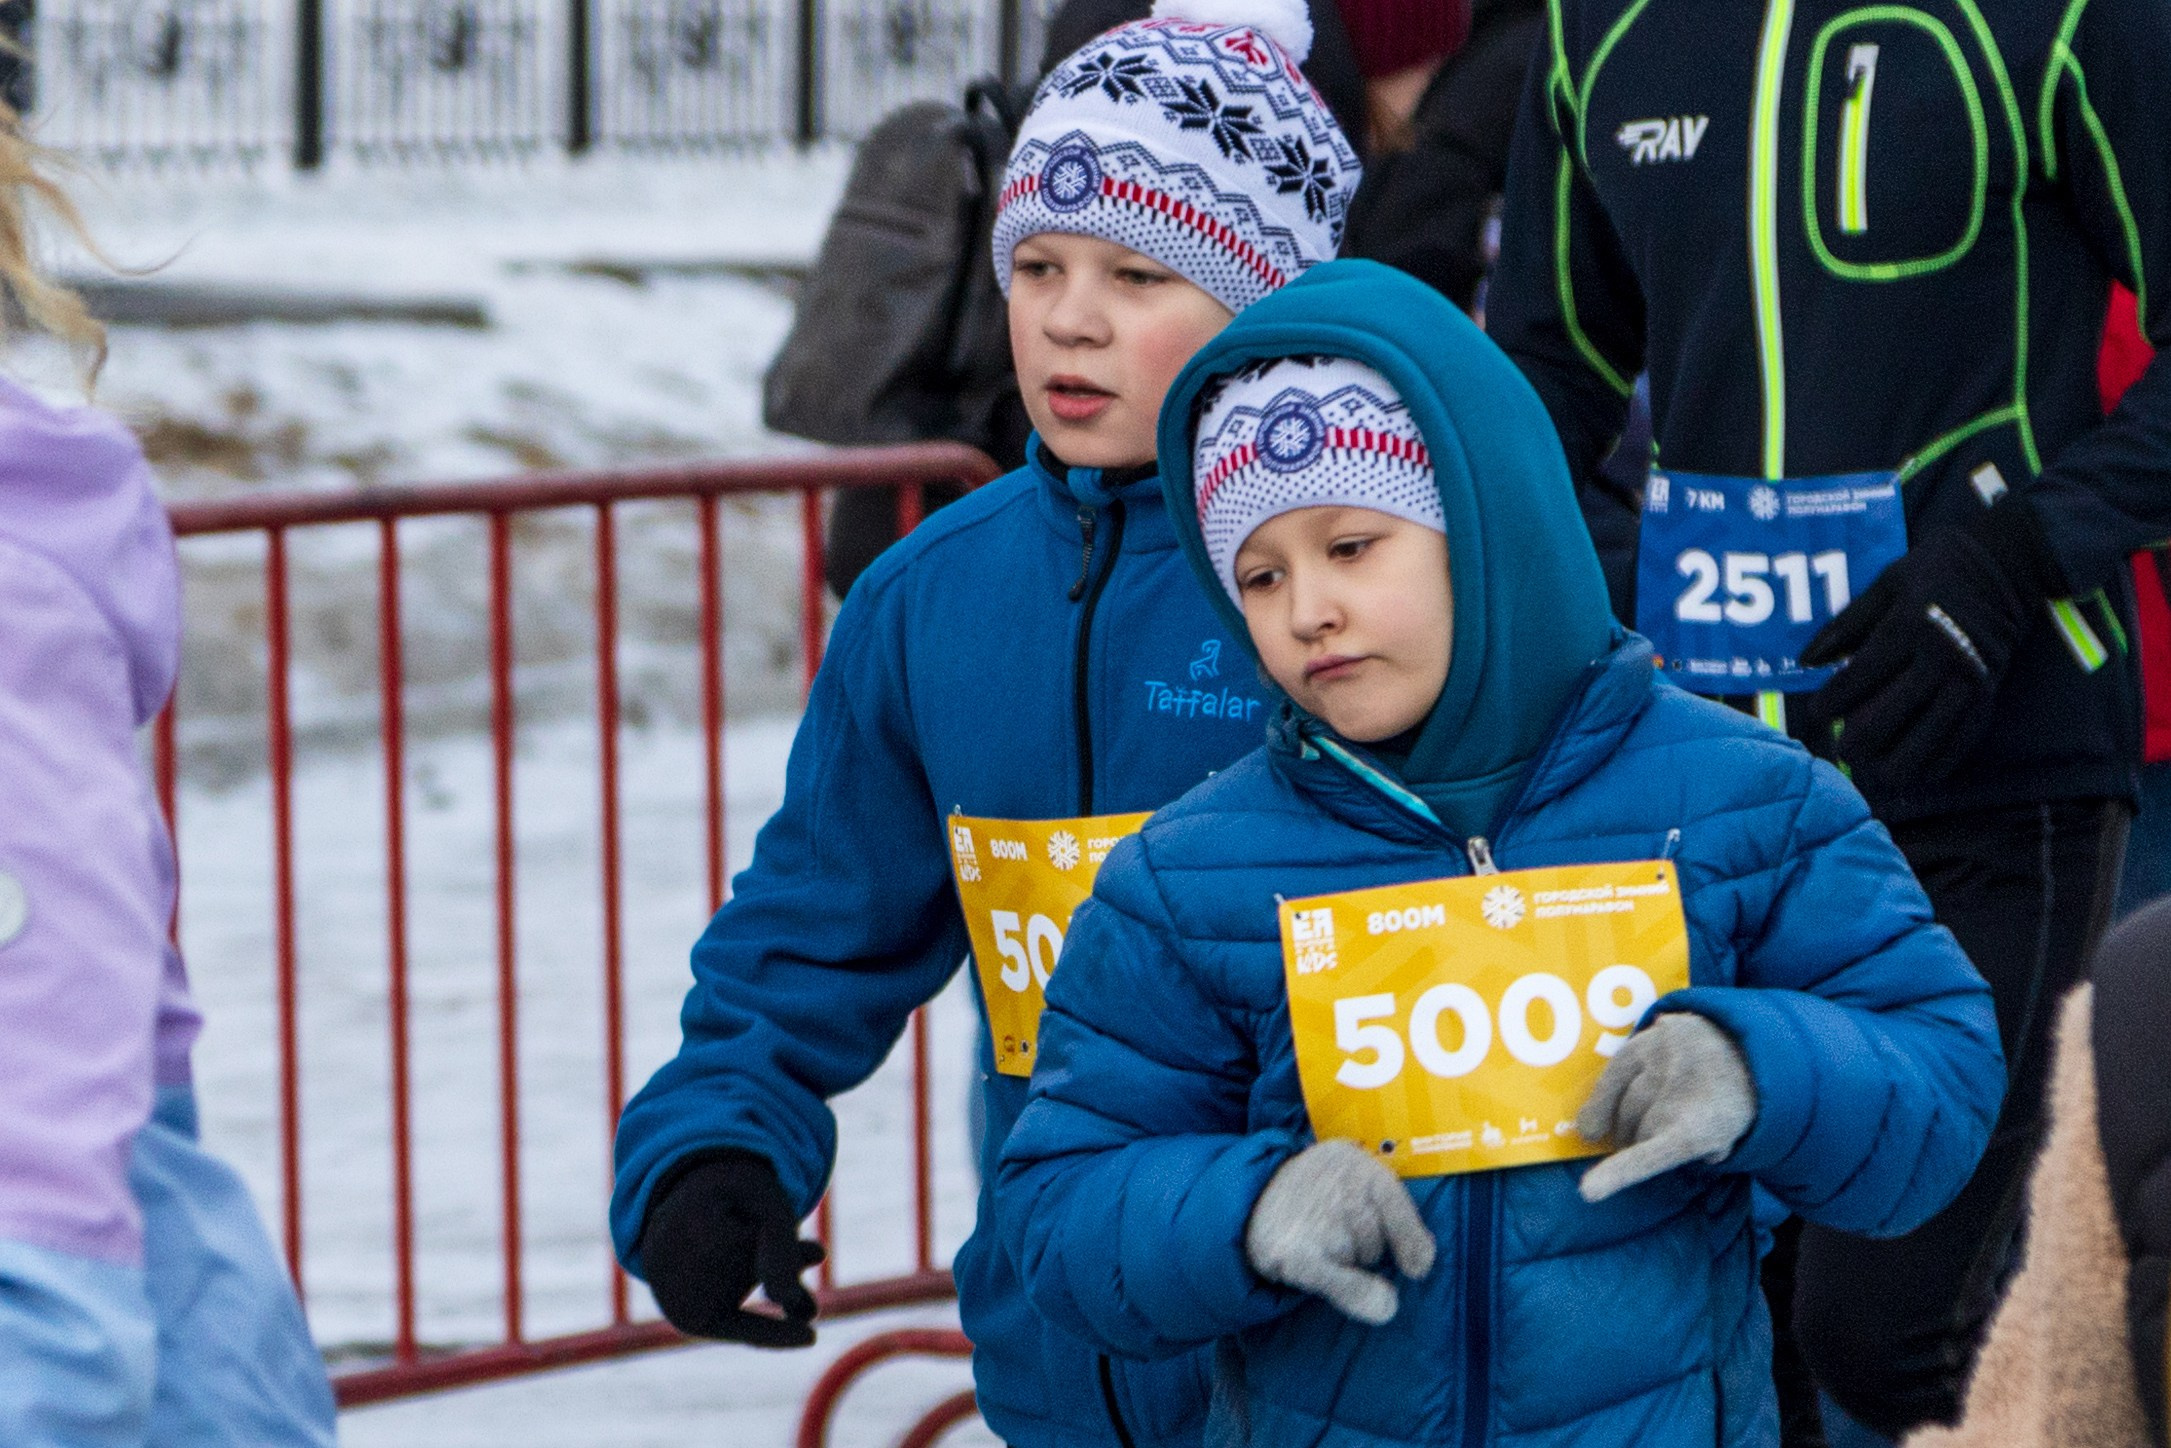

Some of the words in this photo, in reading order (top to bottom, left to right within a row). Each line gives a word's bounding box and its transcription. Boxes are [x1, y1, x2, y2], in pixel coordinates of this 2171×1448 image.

[1685, 486, 1698, 509] 7
[1676, 548, 1851, 624] 2511
[991, 909, 1069, 993] 50
[1333, 964, 1657, 1089] 5009
